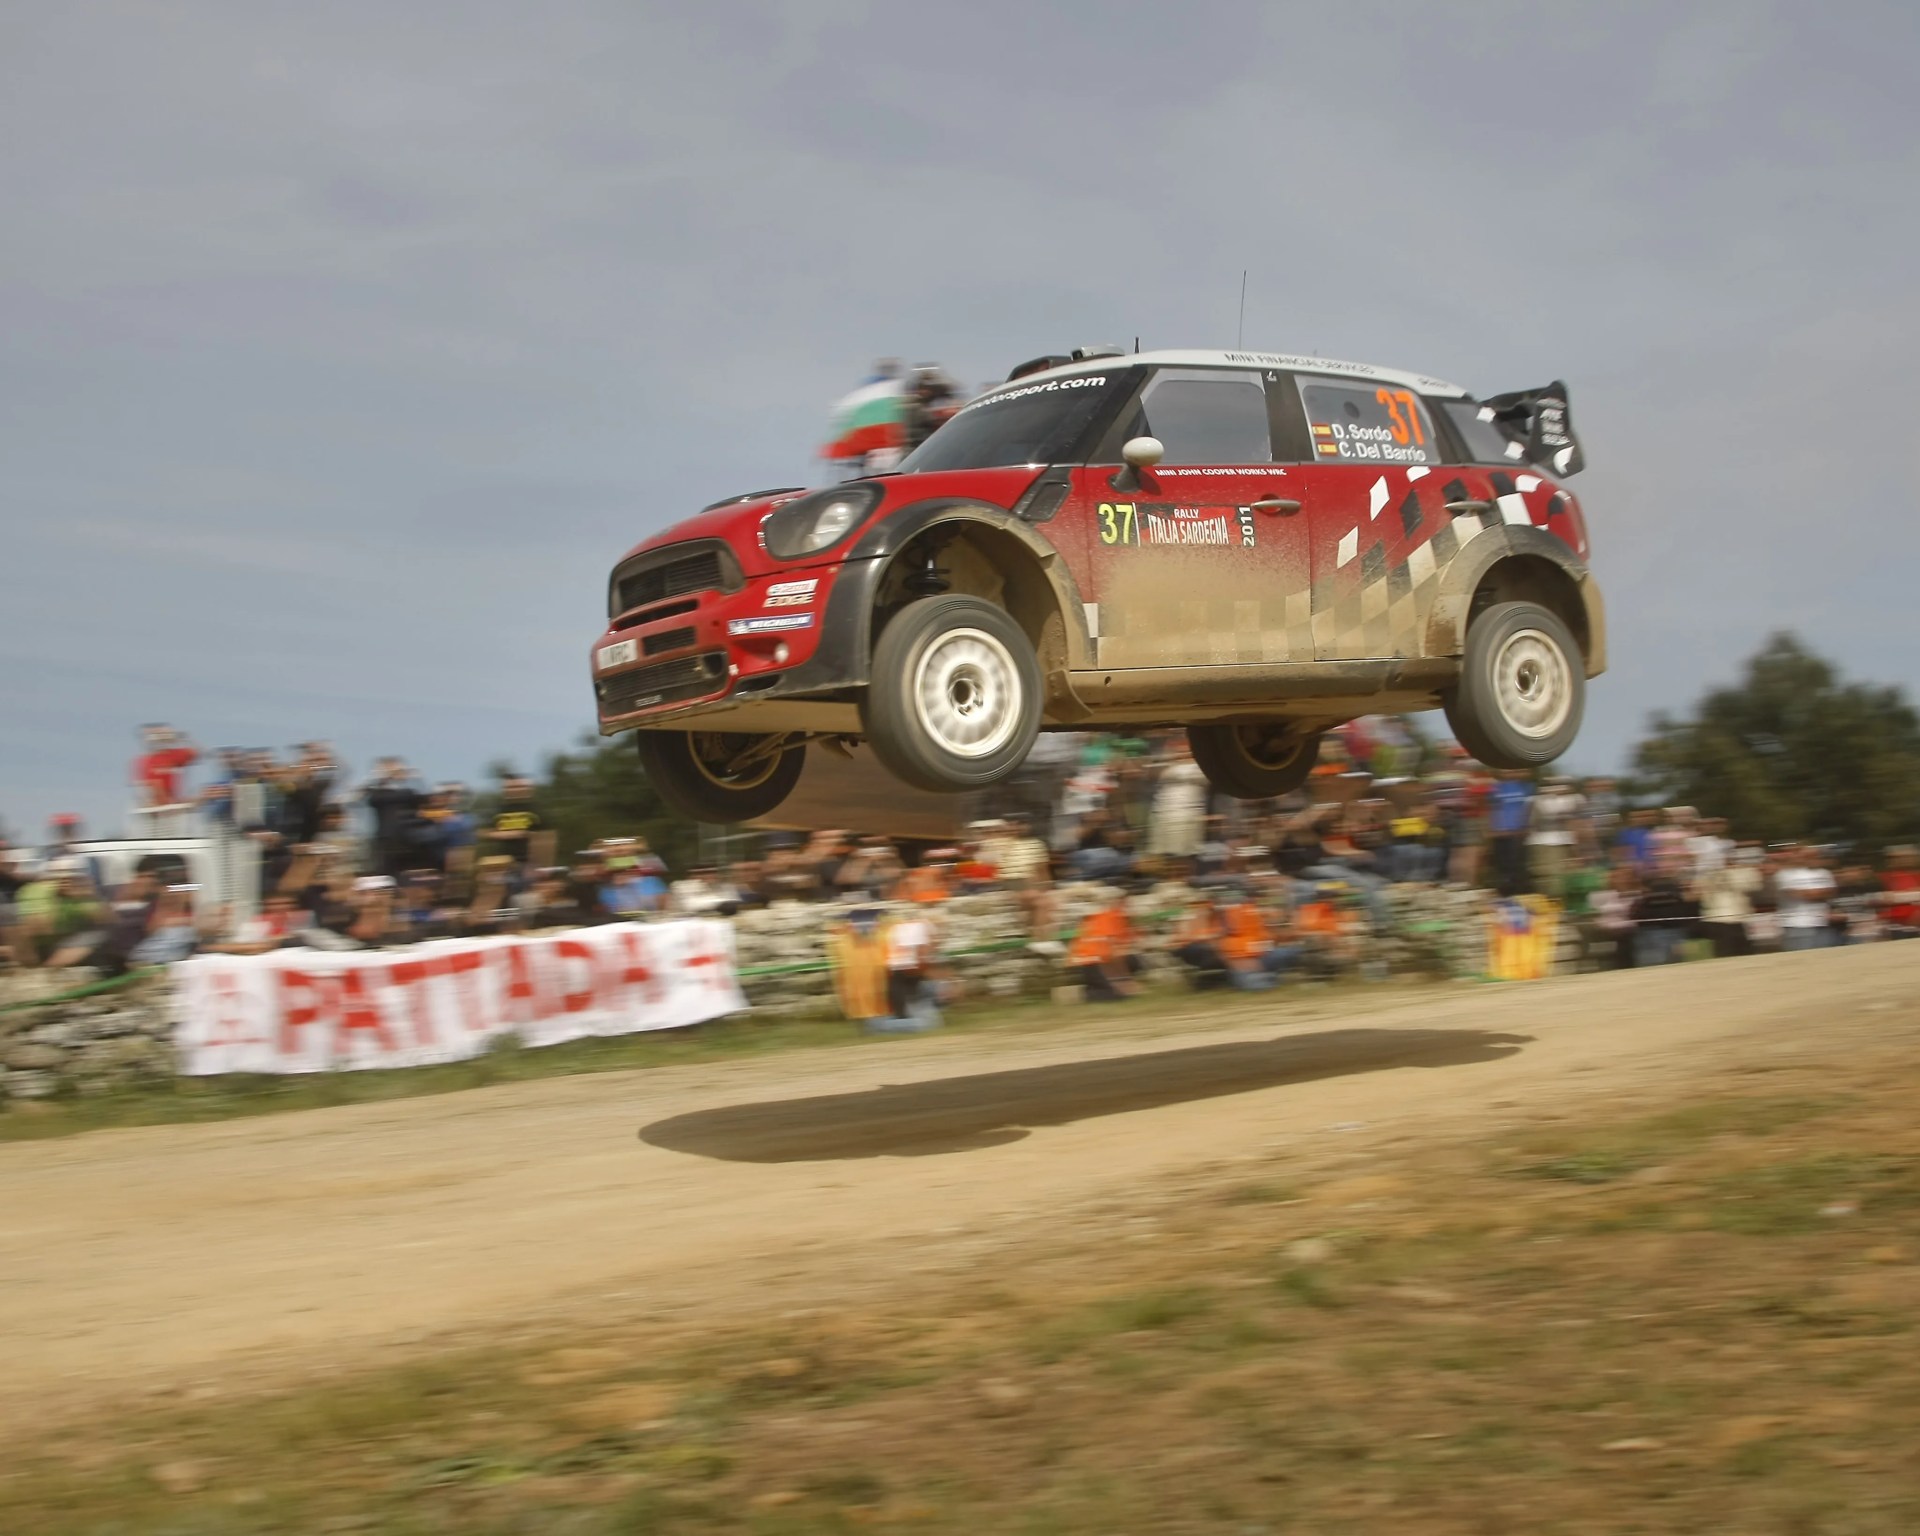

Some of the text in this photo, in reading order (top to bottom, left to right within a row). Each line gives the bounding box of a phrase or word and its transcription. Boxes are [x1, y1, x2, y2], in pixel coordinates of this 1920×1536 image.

[1376, 387, 1425, 447] 37
[1382, 443, 1427, 462] Barrio
[1202, 468, 1237, 476] COOPER
[1236, 468, 1267, 476] WORKS
[1266, 468, 1287, 476] WRC
[1098, 503, 1133, 545] 37
[1147, 513, 1230, 546] ITALIA SARDEGNA
[1173, 508, 1199, 519] RALLY
[1239, 506, 1255, 547] 2011
